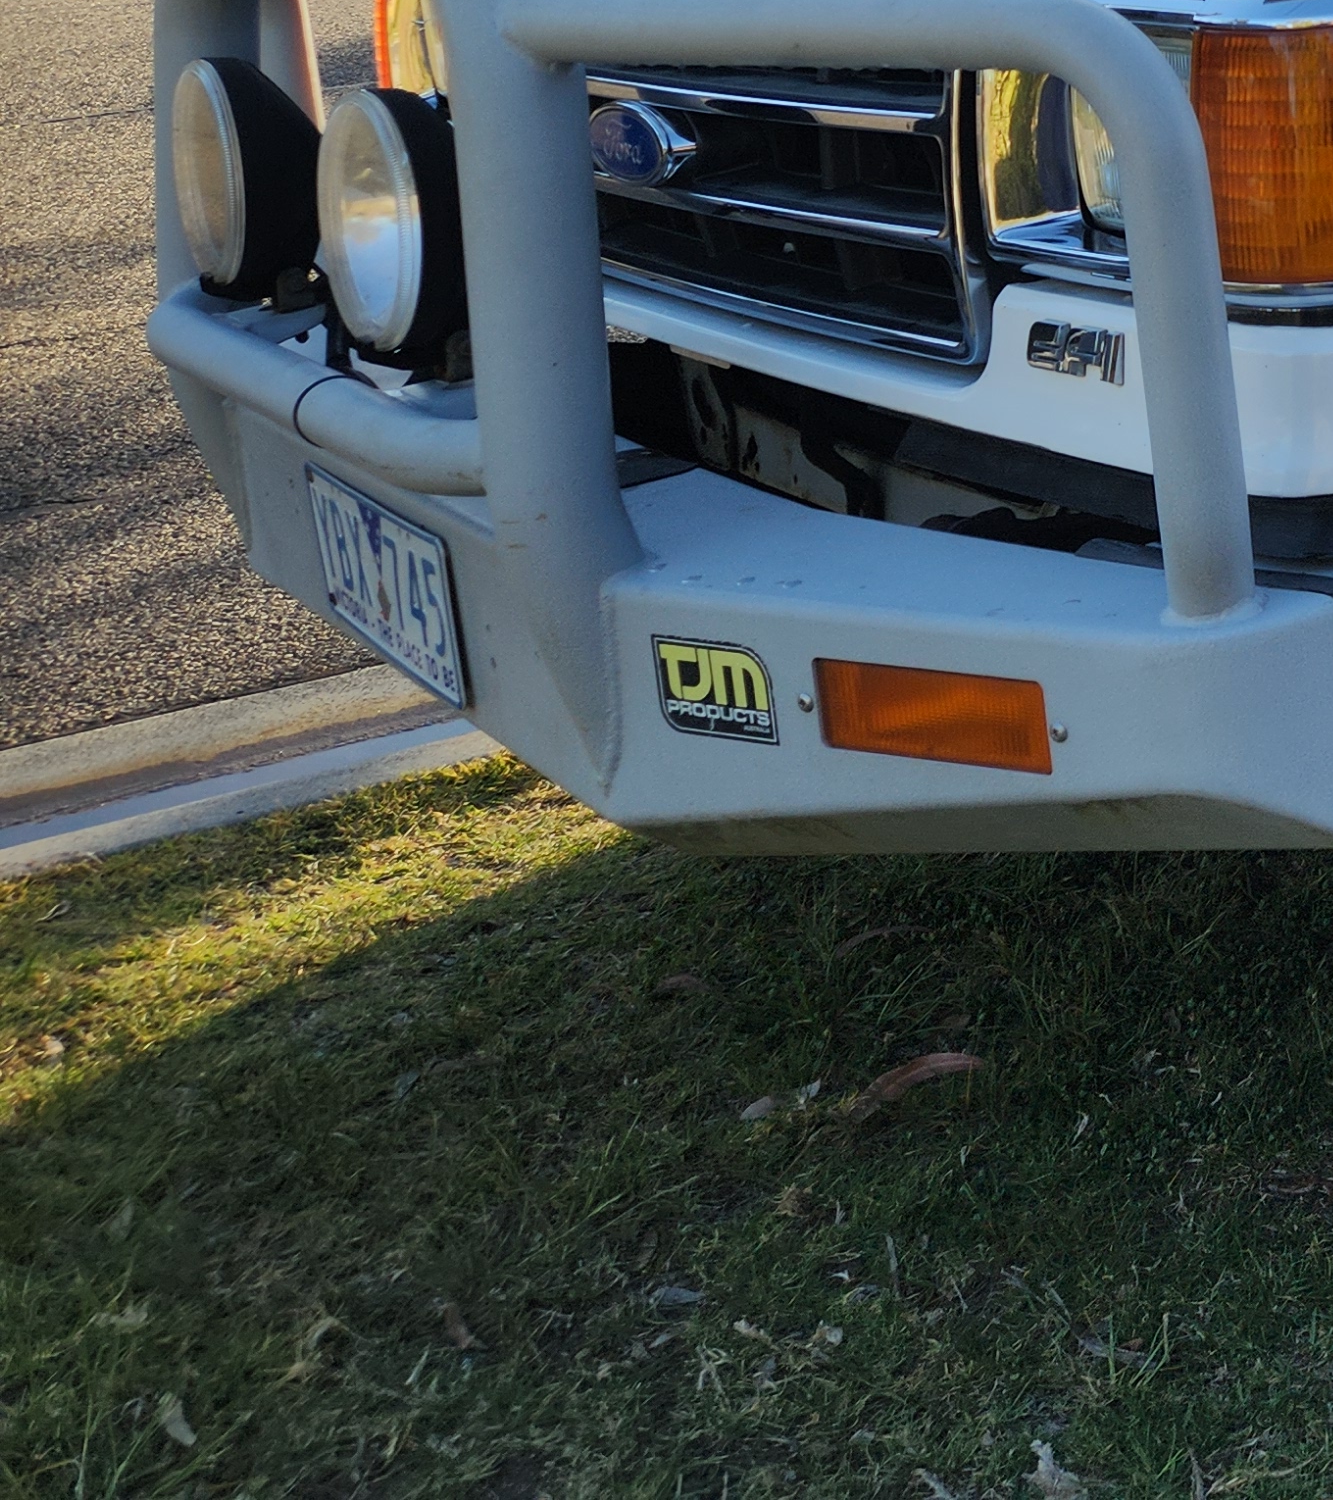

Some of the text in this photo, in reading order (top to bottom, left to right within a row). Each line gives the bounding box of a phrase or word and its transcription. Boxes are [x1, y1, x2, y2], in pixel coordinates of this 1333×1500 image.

[1027, 319, 1125, 387] EFI
[312, 486, 446, 658] YBX 745
[658, 643, 768, 711] TJM
[666, 699, 770, 726] PRODUCTS
